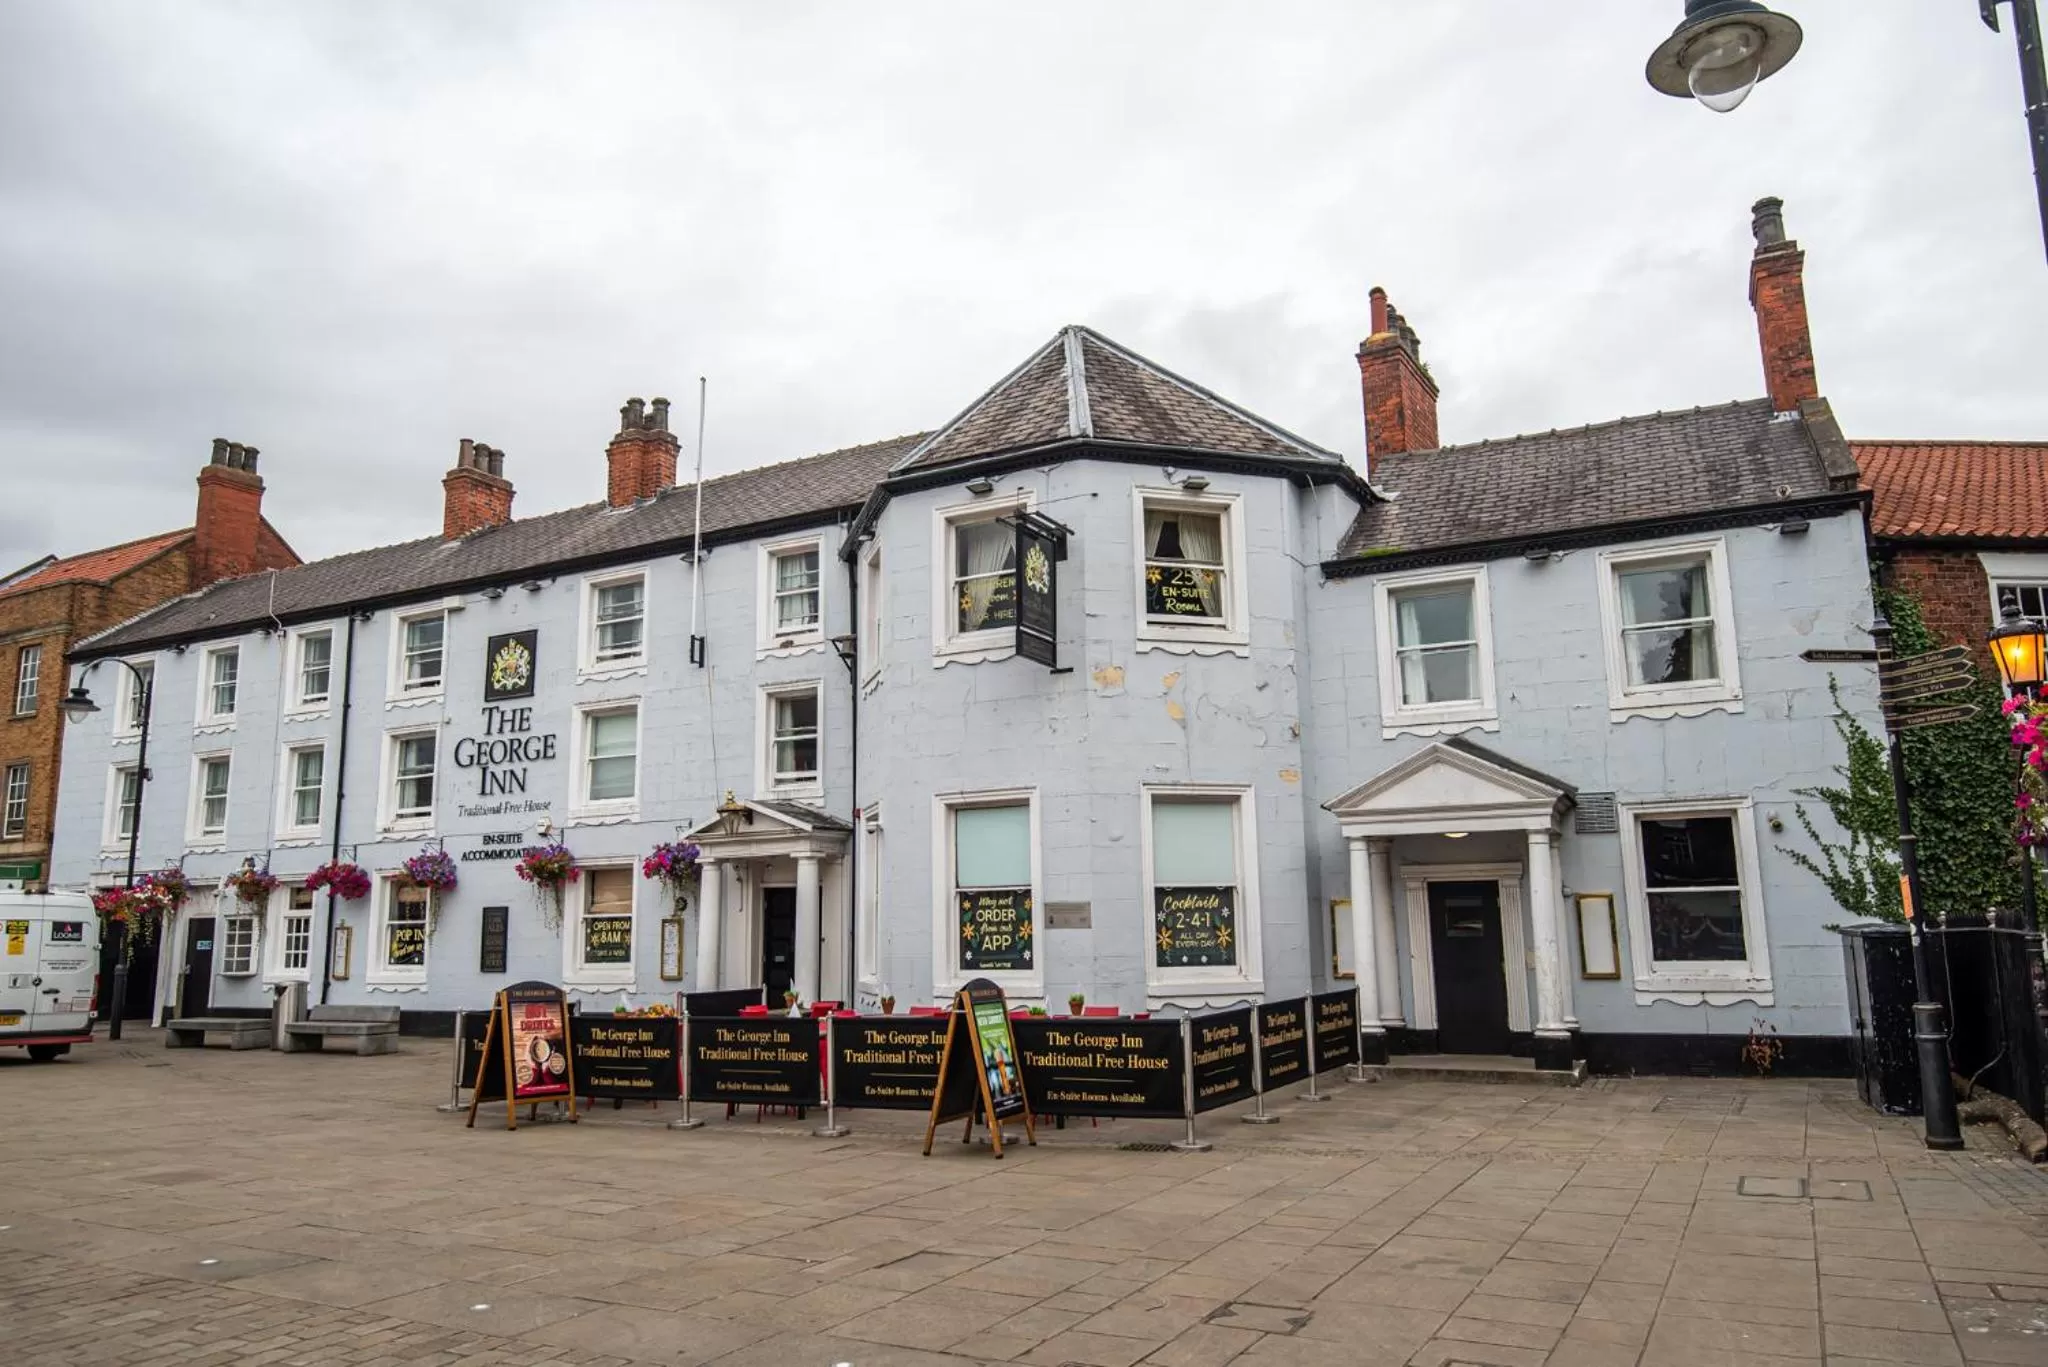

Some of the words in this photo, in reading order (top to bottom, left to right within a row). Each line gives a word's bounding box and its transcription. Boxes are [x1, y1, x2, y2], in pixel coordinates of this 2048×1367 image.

[1170, 568, 1196, 586] 25
[1162, 586, 1209, 599] EN-SUITE
[1165, 598, 1203, 614] Rooms
[482, 706, 532, 736] THE
[454, 733, 557, 769] GEORGE
[477, 766, 528, 796] INN
[458, 802, 502, 818] Traditional
[503, 801, 522, 815] Free
[524, 799, 551, 813] House
[482, 832, 523, 846] EN-SUITE
[1163, 894, 1219, 913] Cocktails
[976, 908, 1016, 922] ORDER
[1176, 911, 1210, 928] 2-4-1
[593, 921, 611, 931] OPEN
[612, 920, 631, 931] FROM
[396, 929, 413, 941] POP
[414, 928, 424, 941] IN
[600, 931, 621, 944] 8AM
[982, 934, 1012, 951] APP
[1180, 932, 1193, 940] ALL
[1195, 932, 1210, 940] DAY
[1175, 940, 1199, 949] EVERY
[1200, 939, 1216, 948] DAY
[591, 1028, 607, 1040] The
[608, 1028, 637, 1044] George
[639, 1028, 653, 1041] Inn
[716, 1029, 735, 1042] The
[737, 1029, 771, 1045] George
[773, 1029, 790, 1042] Inn
[864, 1030, 887, 1044] The
[889, 1030, 929, 1047] George
[931, 1031, 948, 1045] Inn
[1046, 1032, 1071, 1046] The
[1074, 1032, 1118, 1050] George
[1121, 1033, 1143, 1048] Inn
[576, 1044, 620, 1058] Traditional
[622, 1046, 641, 1058] Free
[643, 1046, 670, 1058] House
[699, 1047, 751, 1060] Traditional
[754, 1048, 776, 1061] Free
[778, 1048, 808, 1062] House
[844, 1049, 906, 1063] Traditional
[908, 1050, 933, 1064] Free
[1024, 1051, 1092, 1067] Traditional
[1096, 1053, 1124, 1068] Free
[1128, 1054, 1169, 1069] House
[1047, 1090, 1081, 1101] En-Suite
[1082, 1092, 1108, 1102] Rooms
[1109, 1092, 1146, 1104] Available
